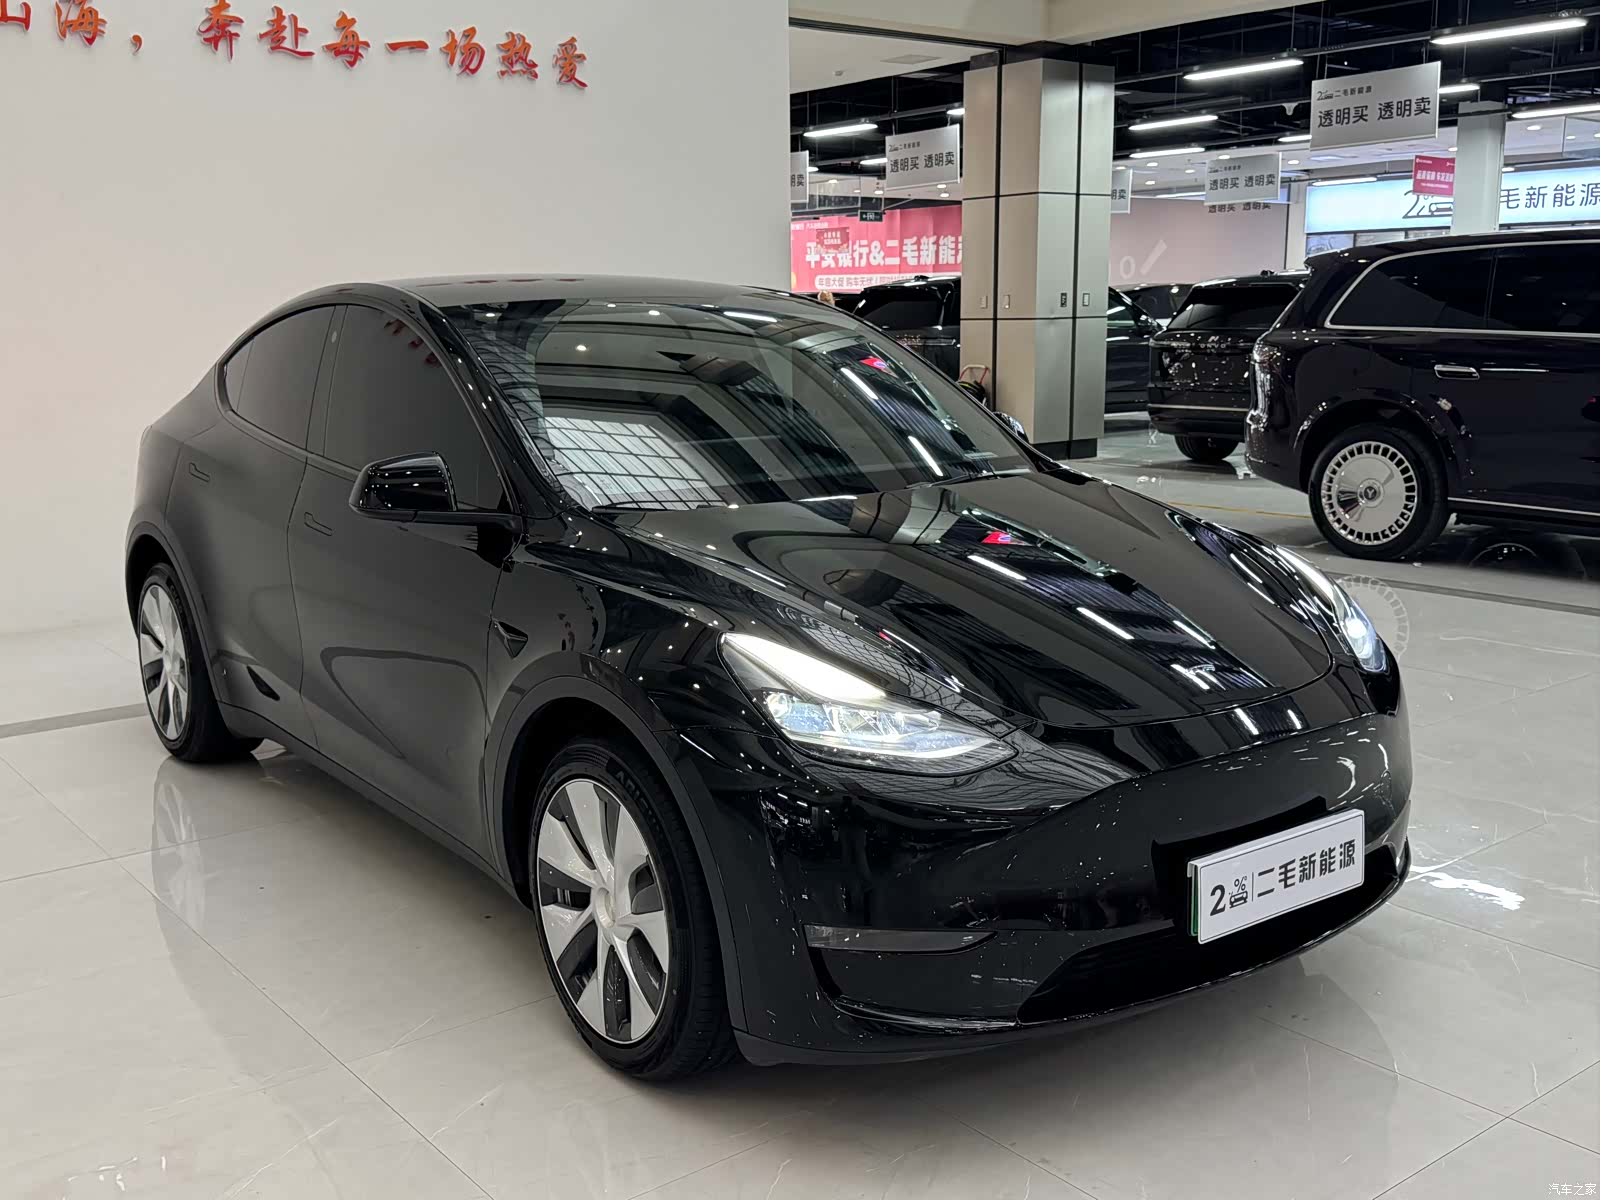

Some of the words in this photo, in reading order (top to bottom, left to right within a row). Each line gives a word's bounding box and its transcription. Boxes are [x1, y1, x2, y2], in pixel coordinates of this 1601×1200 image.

[1317, 105, 1369, 128] 透明买
[1377, 96, 1431, 121] 透明卖
[890, 156, 919, 173] 透明买
[924, 151, 955, 168] 透明卖
[1209, 177, 1240, 191] 透明买
[1244, 173, 1276, 188] 透明卖
[1257, 838, 1356, 898] 二毛新能源
